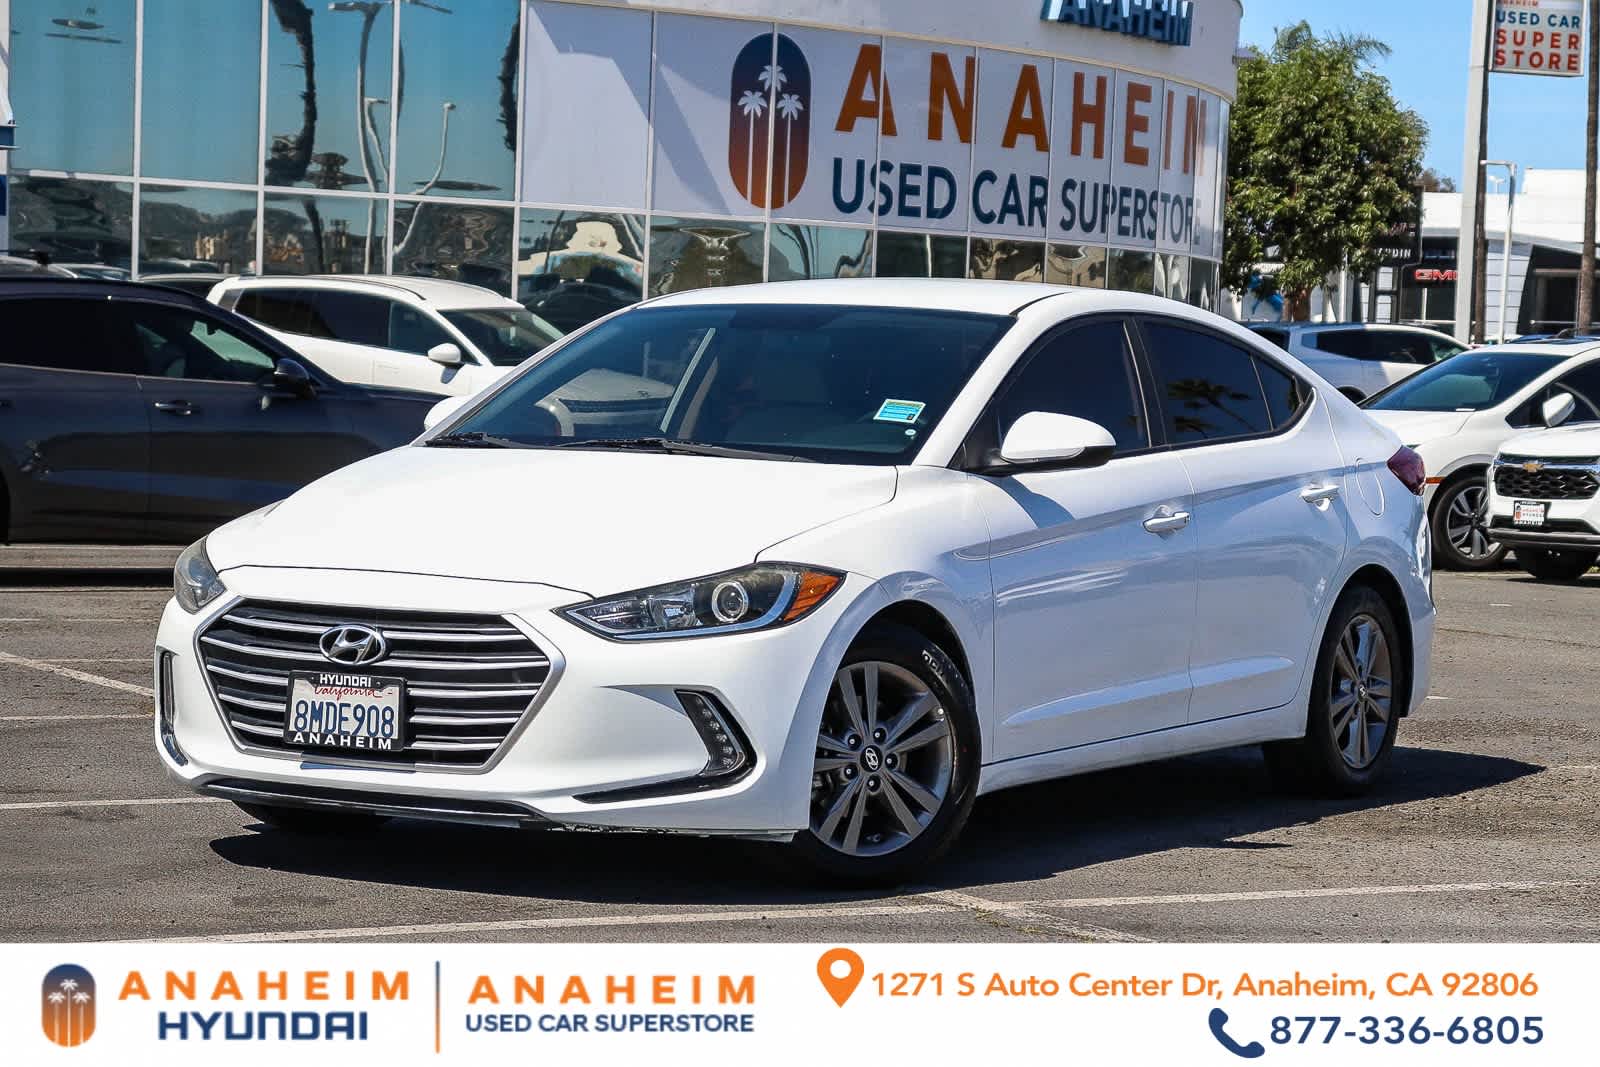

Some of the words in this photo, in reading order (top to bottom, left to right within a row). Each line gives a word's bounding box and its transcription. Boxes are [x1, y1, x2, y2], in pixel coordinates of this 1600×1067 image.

[1496, 9, 1540, 25] USED
[1547, 13, 1580, 28] CAR
[1496, 28, 1580, 50] SUPER
[1495, 49, 1579, 71] STORE
[832, 157, 957, 219] USED
[972, 168, 1048, 228] CAR
[319, 673, 372, 688] HYUNDAI
[294, 699, 395, 738] 8MDE908
[293, 731, 392, 750] ANAHEIM
